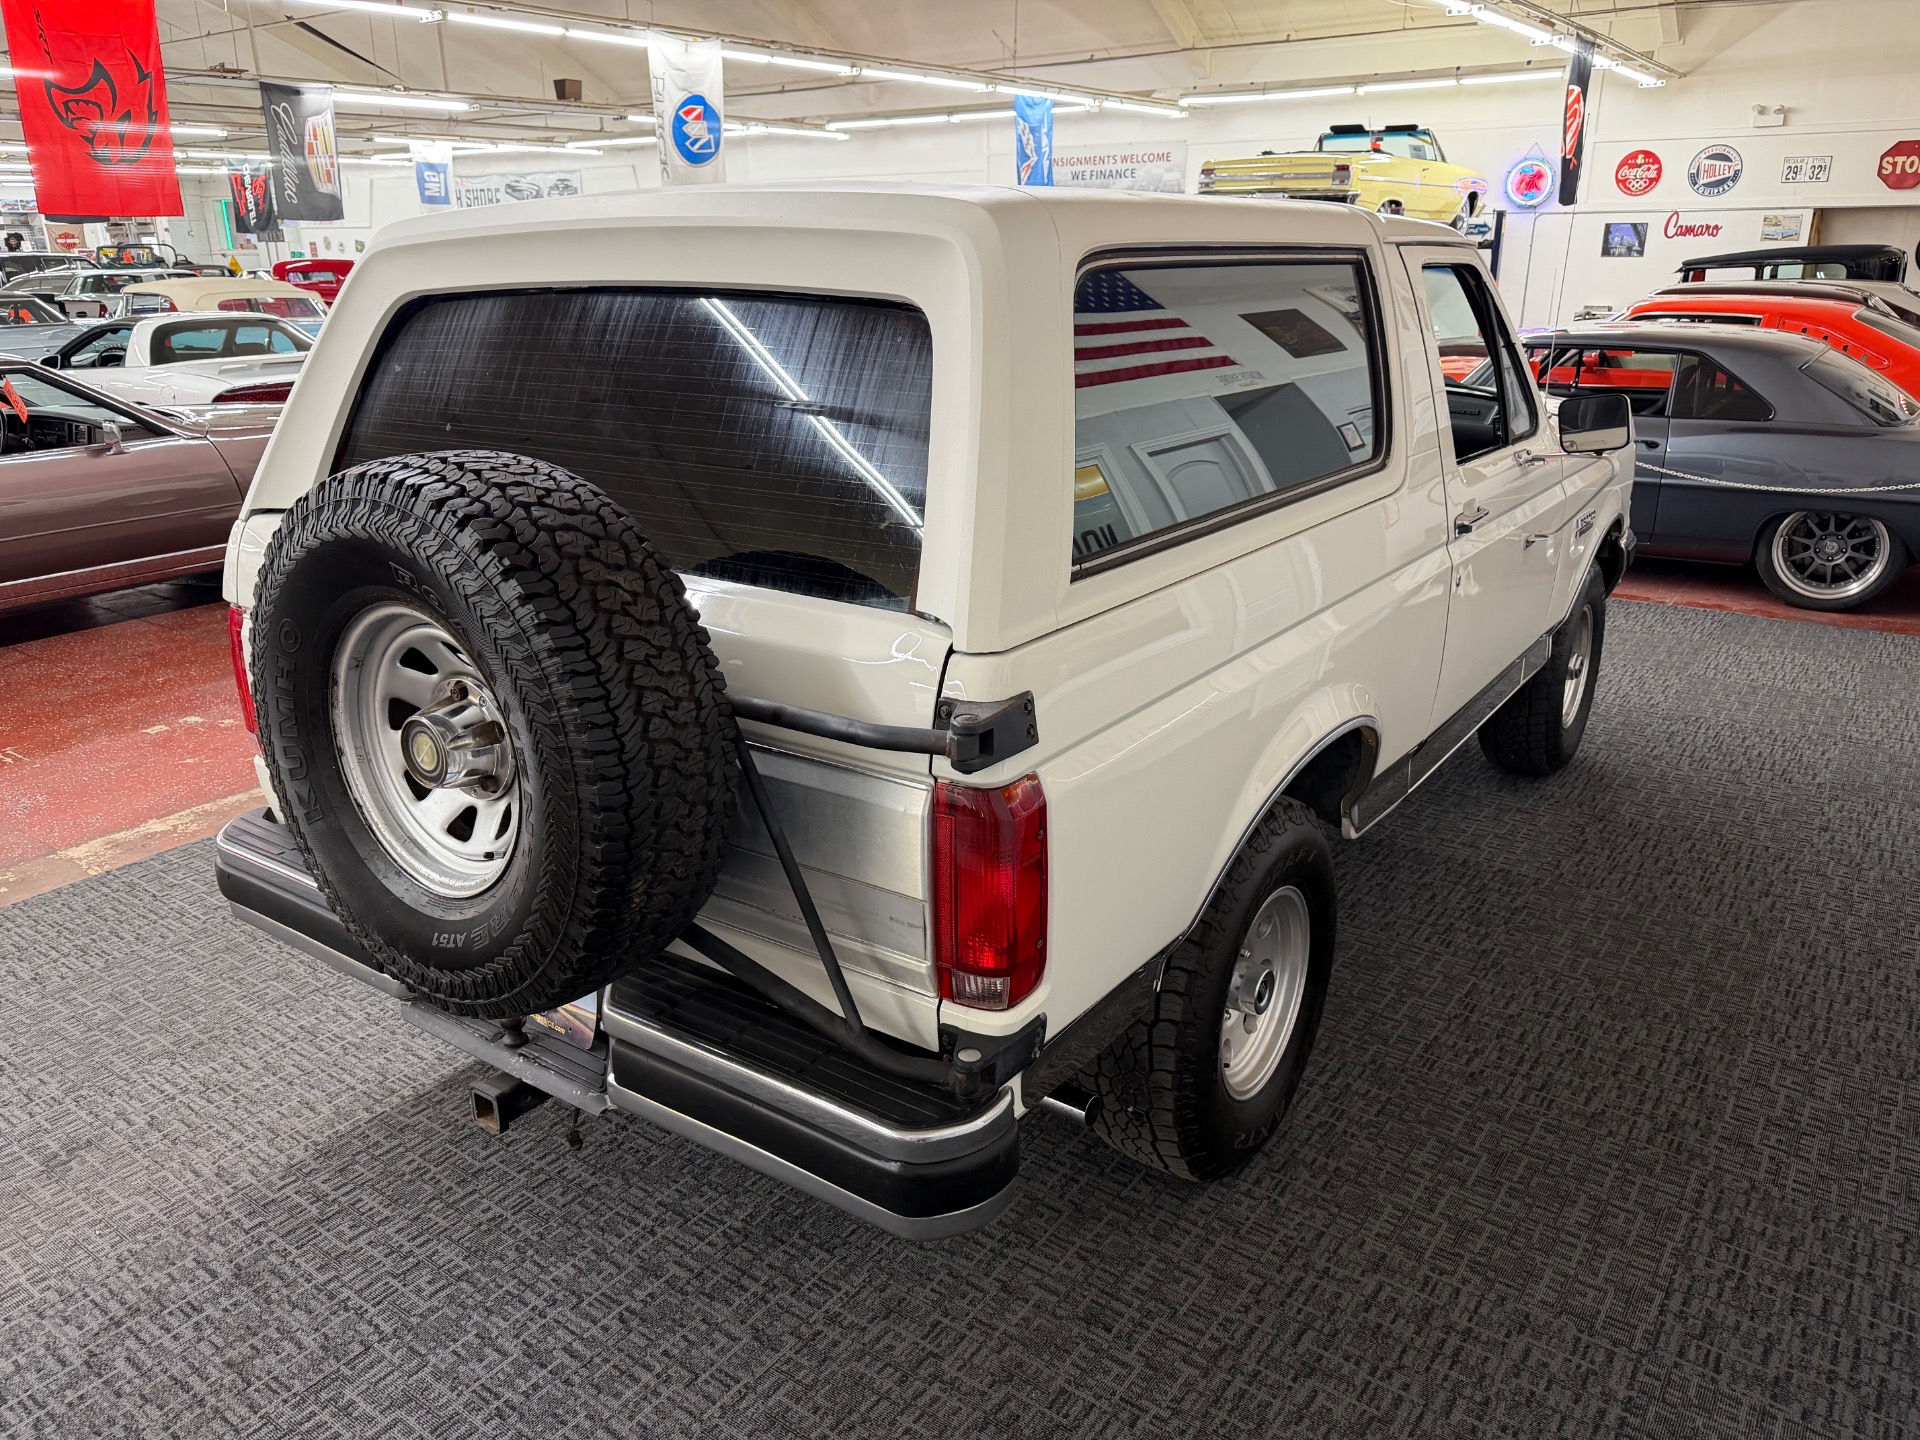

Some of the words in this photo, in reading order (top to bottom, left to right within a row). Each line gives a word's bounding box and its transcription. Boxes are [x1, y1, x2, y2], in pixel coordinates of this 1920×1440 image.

[270, 102, 299, 204] Cadillac
[1052, 155, 1117, 168] NSIGNMENTS
[1120, 152, 1172, 164] WELCOME
[1702, 163, 1733, 180] HOLLEY
[1881, 155, 1920, 174] STO
[1071, 170, 1087, 181] WE
[1089, 168, 1136, 180] FINANCE
[1663, 210, 1723, 239] Camaro
[274, 618, 325, 826] KUMHO
[431, 931, 468, 949] AT51
